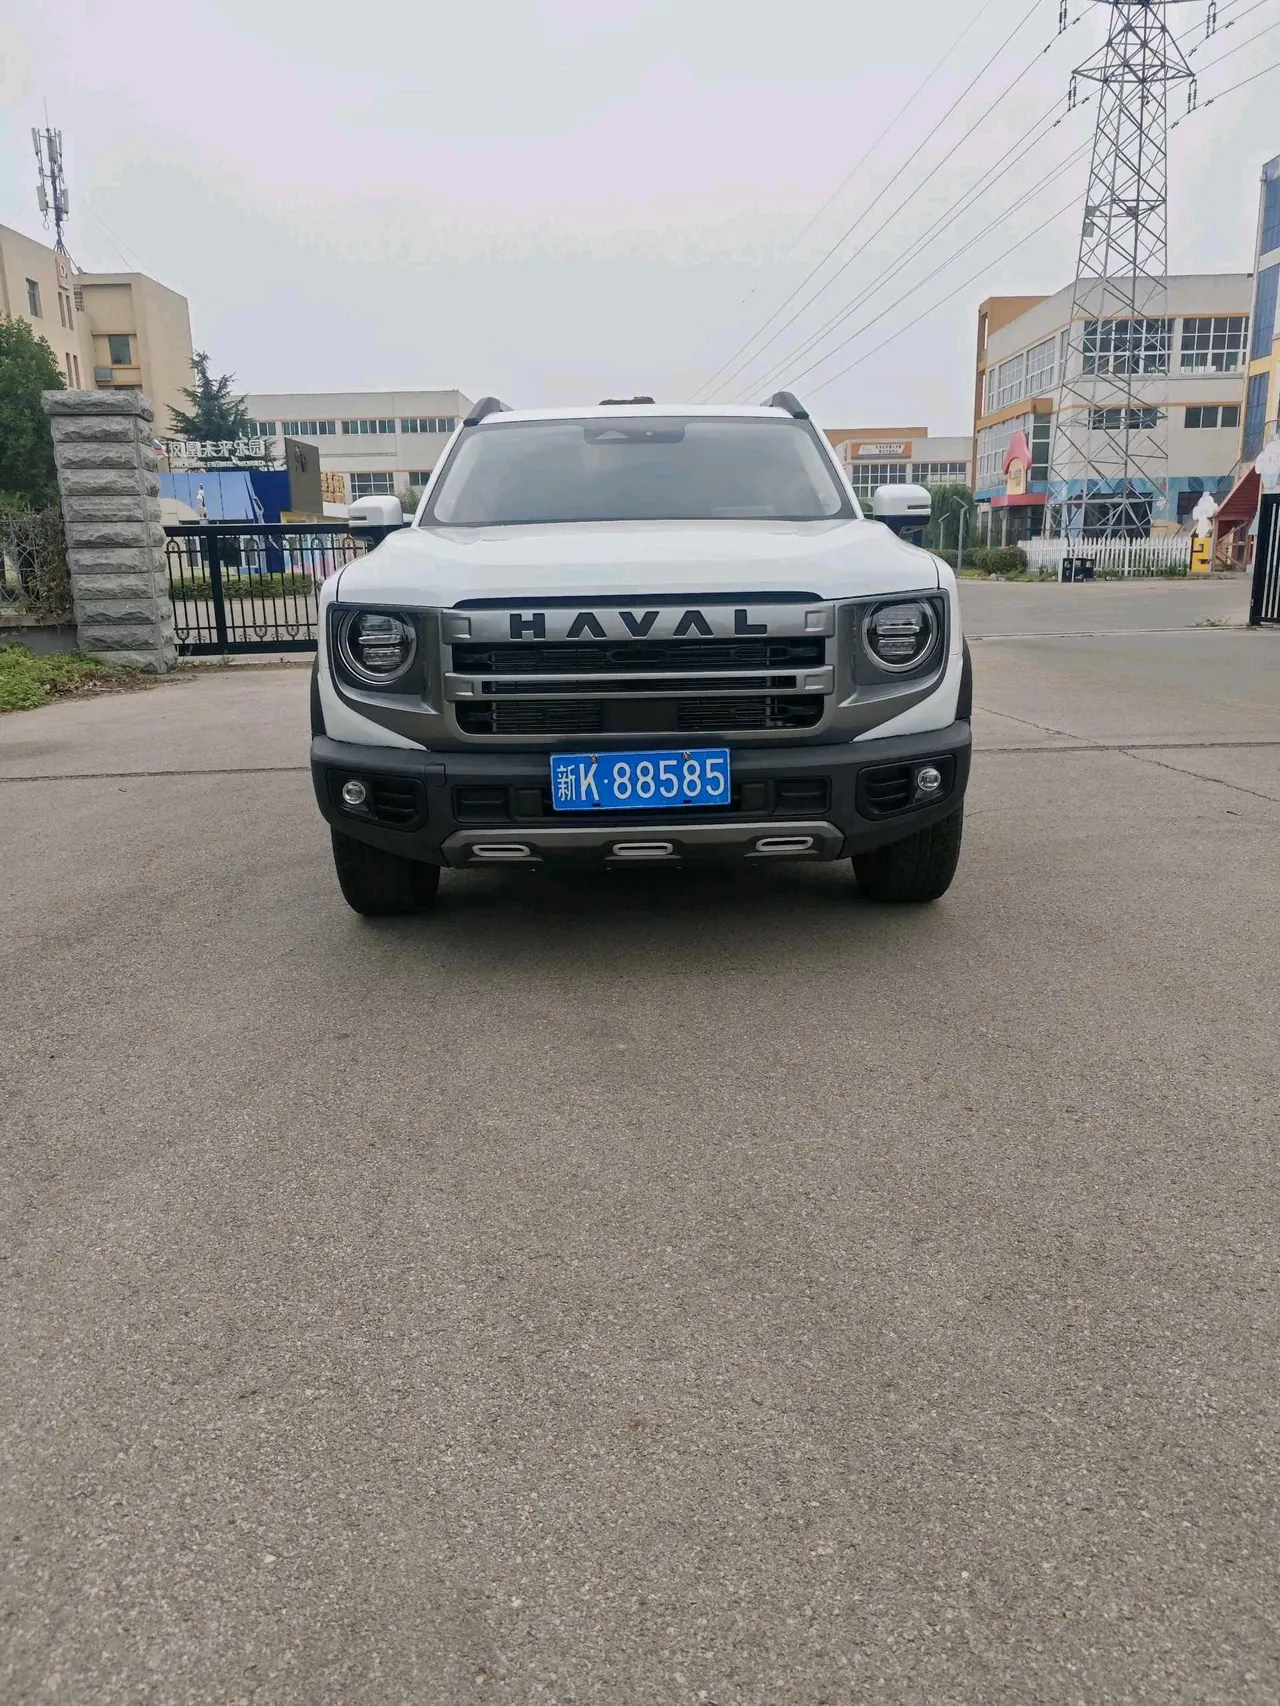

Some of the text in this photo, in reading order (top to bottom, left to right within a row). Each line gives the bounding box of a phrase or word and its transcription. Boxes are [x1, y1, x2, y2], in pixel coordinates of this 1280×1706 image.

[170, 440, 265, 457] 凤凰未来乐园
[509, 609, 768, 640] HAVAL
[555, 757, 726, 802] 新K·88585
